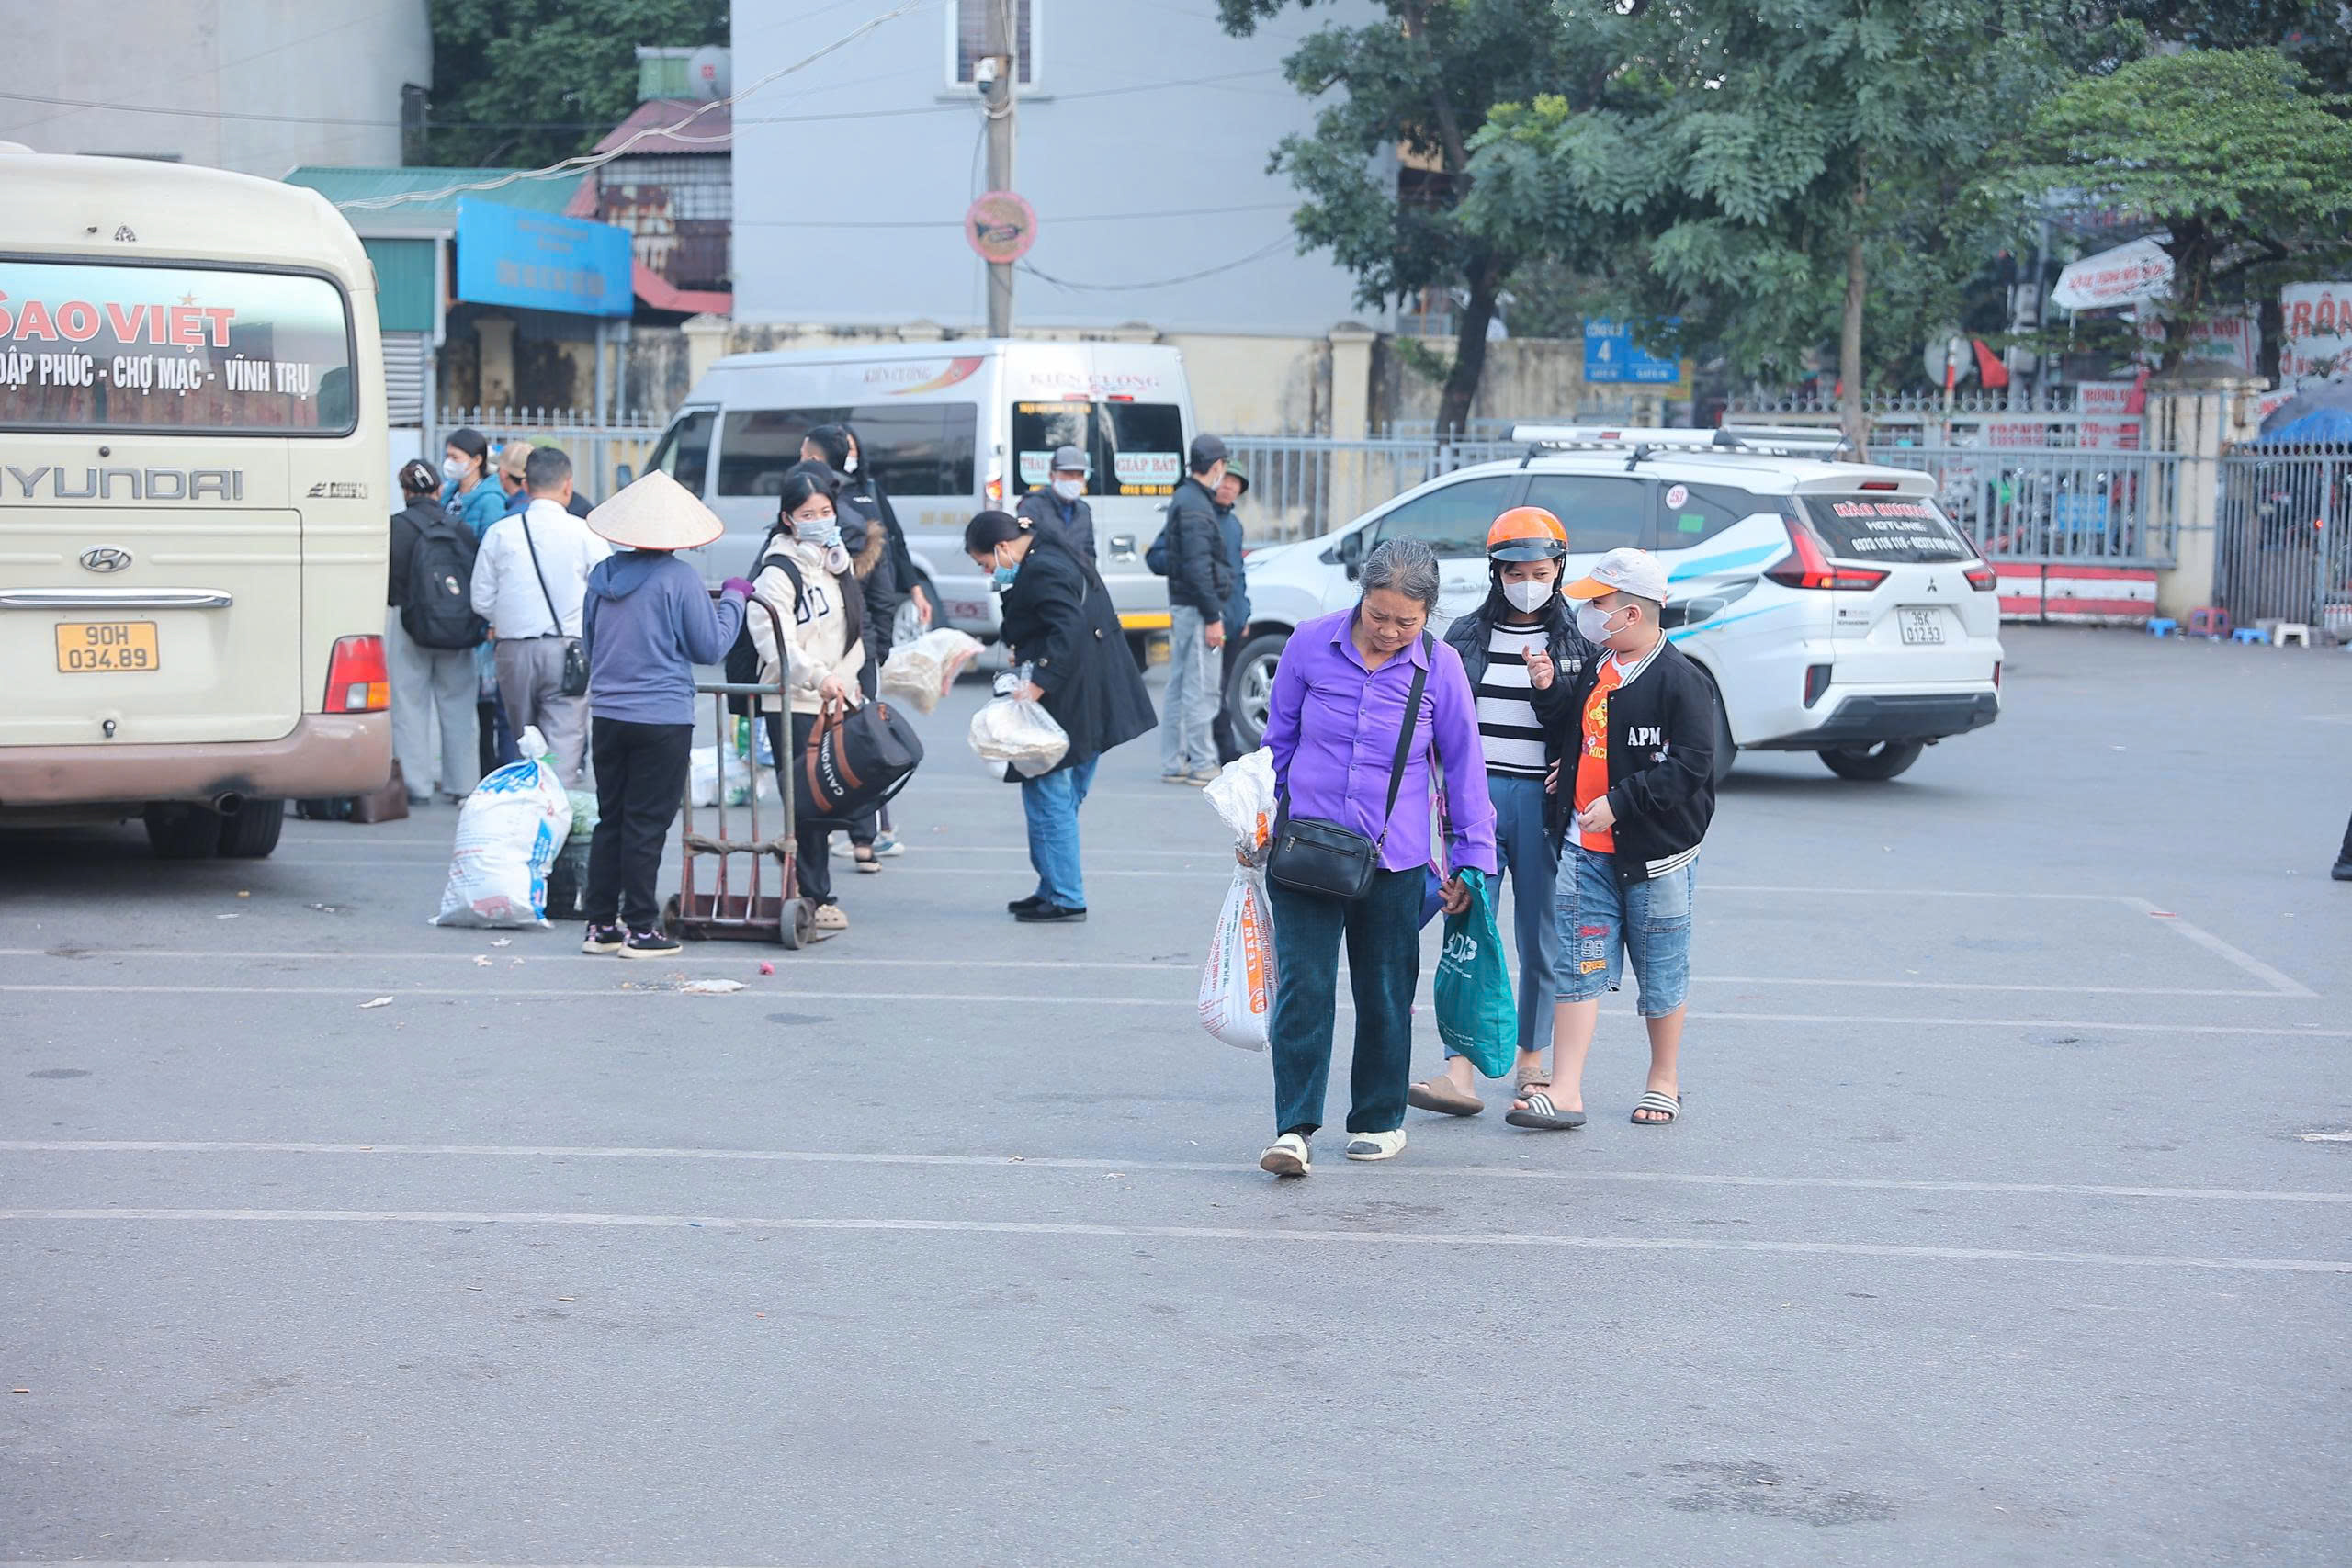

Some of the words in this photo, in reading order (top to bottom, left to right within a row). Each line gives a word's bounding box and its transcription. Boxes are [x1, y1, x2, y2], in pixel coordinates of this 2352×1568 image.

[105, 301, 235, 353] VIỆT
[1597, 339, 1611, 362] 4
[39, 346, 95, 387] PHÚC
[112, 353, 153, 396] CHỢ
[157, 355, 201, 396] MẠC
[225, 353, 270, 392] VĨNH
[275, 362, 310, 400] TRỤ
[0, 465, 243, 501] YUNDAI
[1912, 611, 1929, 626] 36K
[85, 626, 129, 646] 90H
[68, 649, 148, 670] 034.89
[1628, 726, 1661, 747] APM
[1245, 927, 1257, 971] LEAN
[1581, 940, 1605, 958] 96
